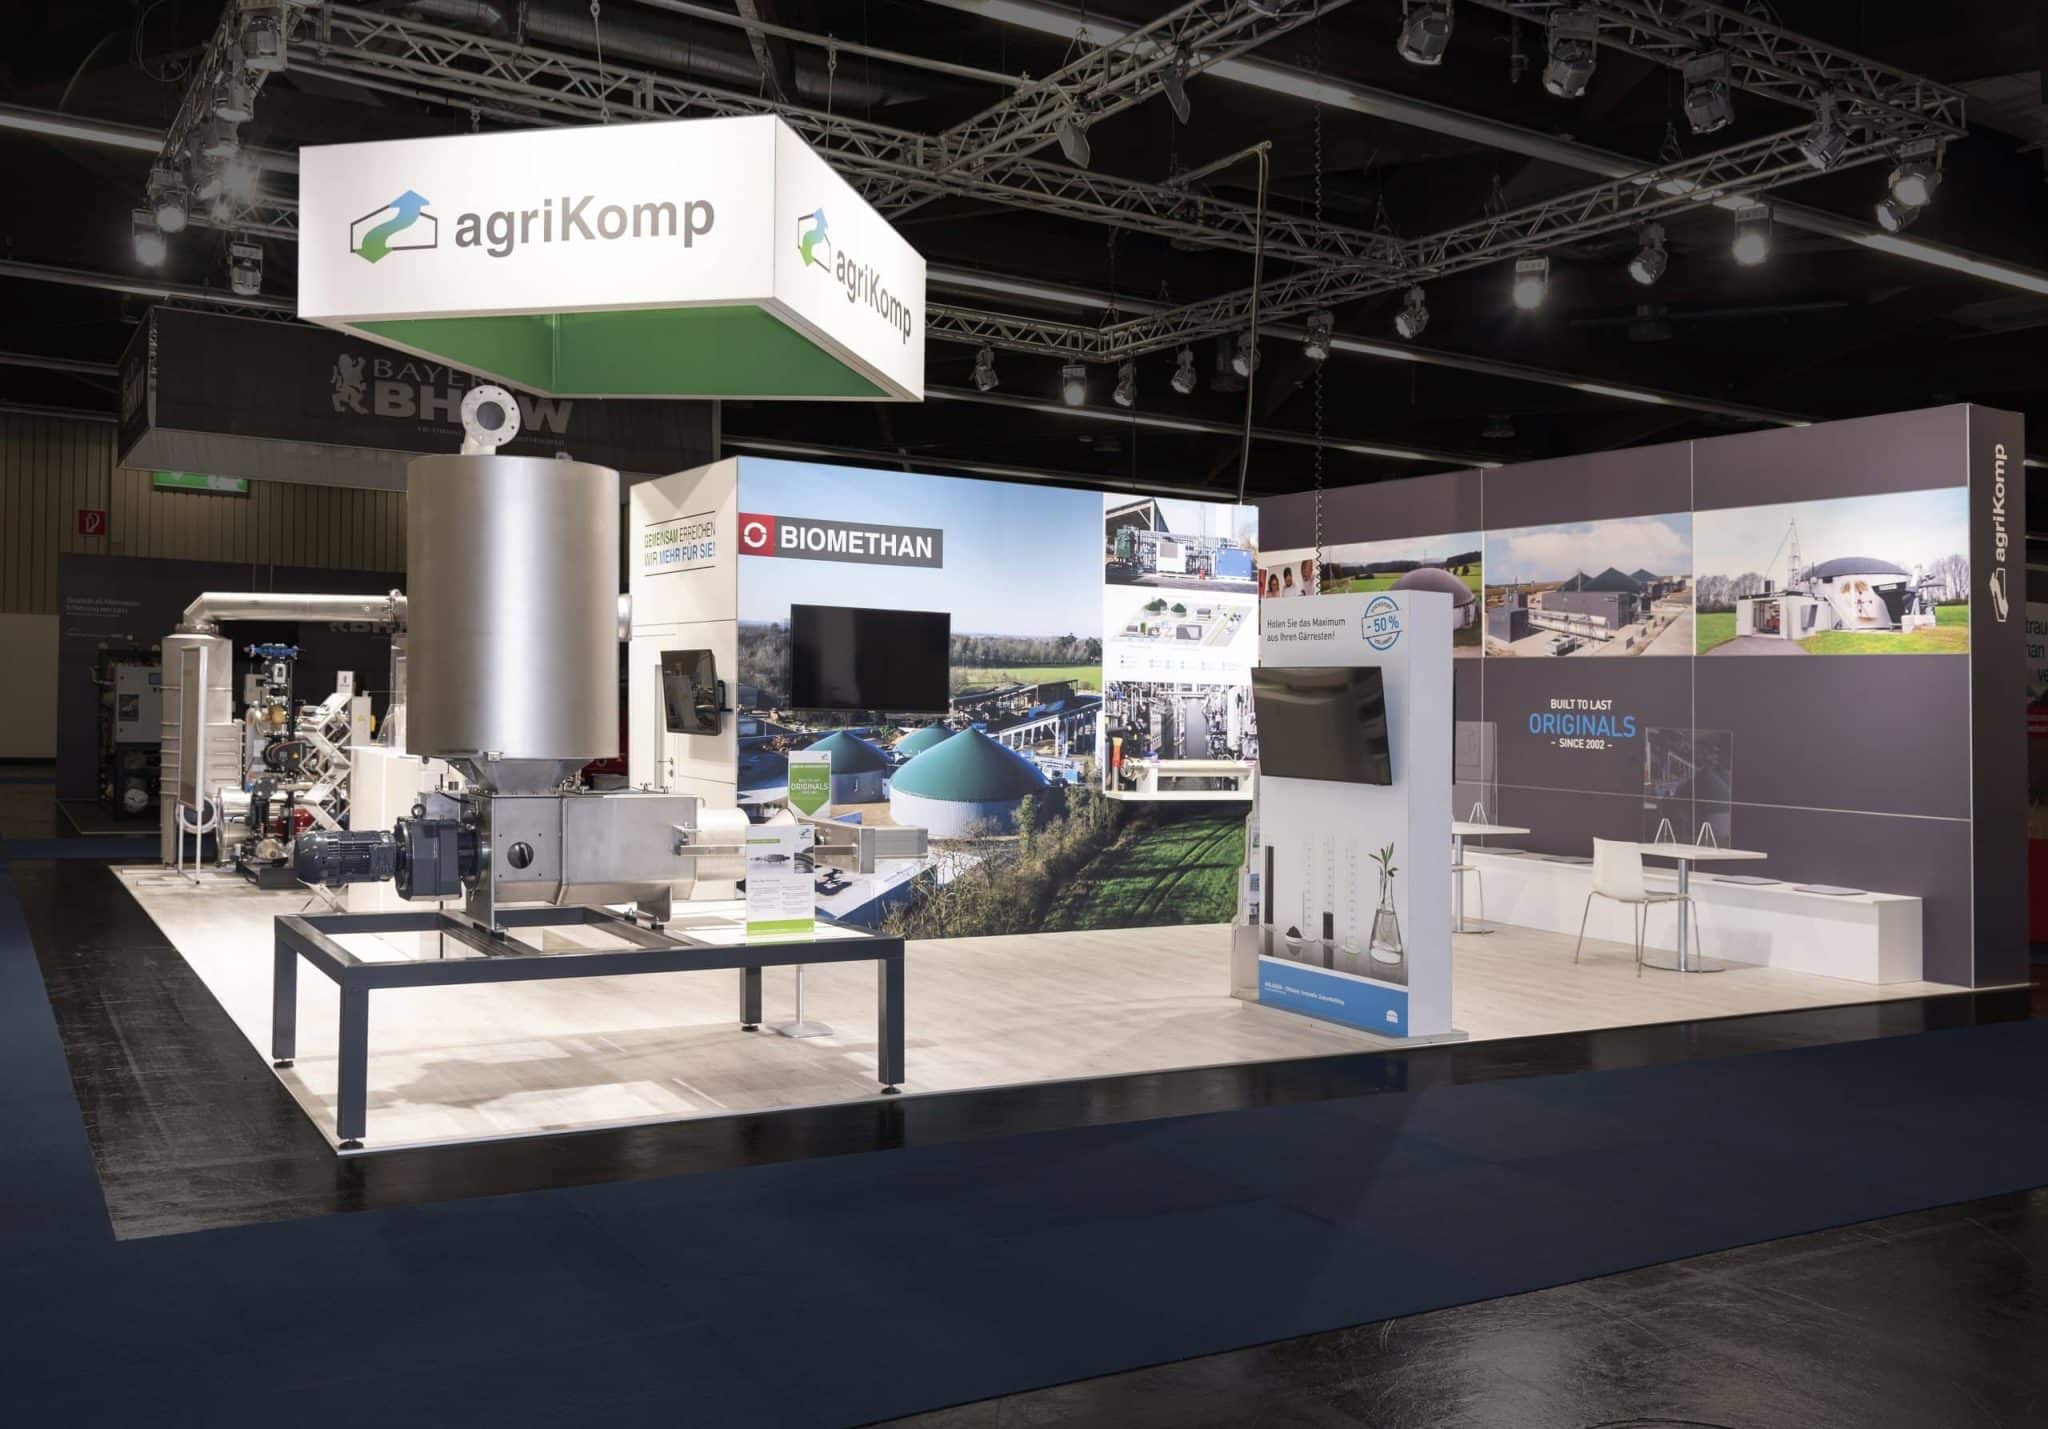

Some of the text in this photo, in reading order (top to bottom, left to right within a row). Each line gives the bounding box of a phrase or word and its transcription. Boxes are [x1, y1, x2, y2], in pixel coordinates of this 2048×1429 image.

[455, 195, 715, 258] agriKomp
[835, 248, 912, 344] agriKomp
[373, 381, 572, 434] BHW
[1992, 443, 2008, 562] agriKomp
[679, 521, 716, 542] ERREICHEN
[779, 525, 933, 558] BIOMETHAN
[659, 547, 680, 564] MEHR
[682, 543, 698, 561] FÜR
[1267, 617, 1346, 629] Holen Sie das Maximum
[1374, 617, 1387, 633] 50
[1388, 614, 1400, 630] %
[1267, 631, 1336, 642] aus Ihren Gärresten!
[1550, 698, 1613, 711] BUILT TO LAST
[1529, 712, 1637, 738] ORIGINALS
[1559, 738, 1585, 749] SINCE
[1585, 739, 1605, 750] 2002
